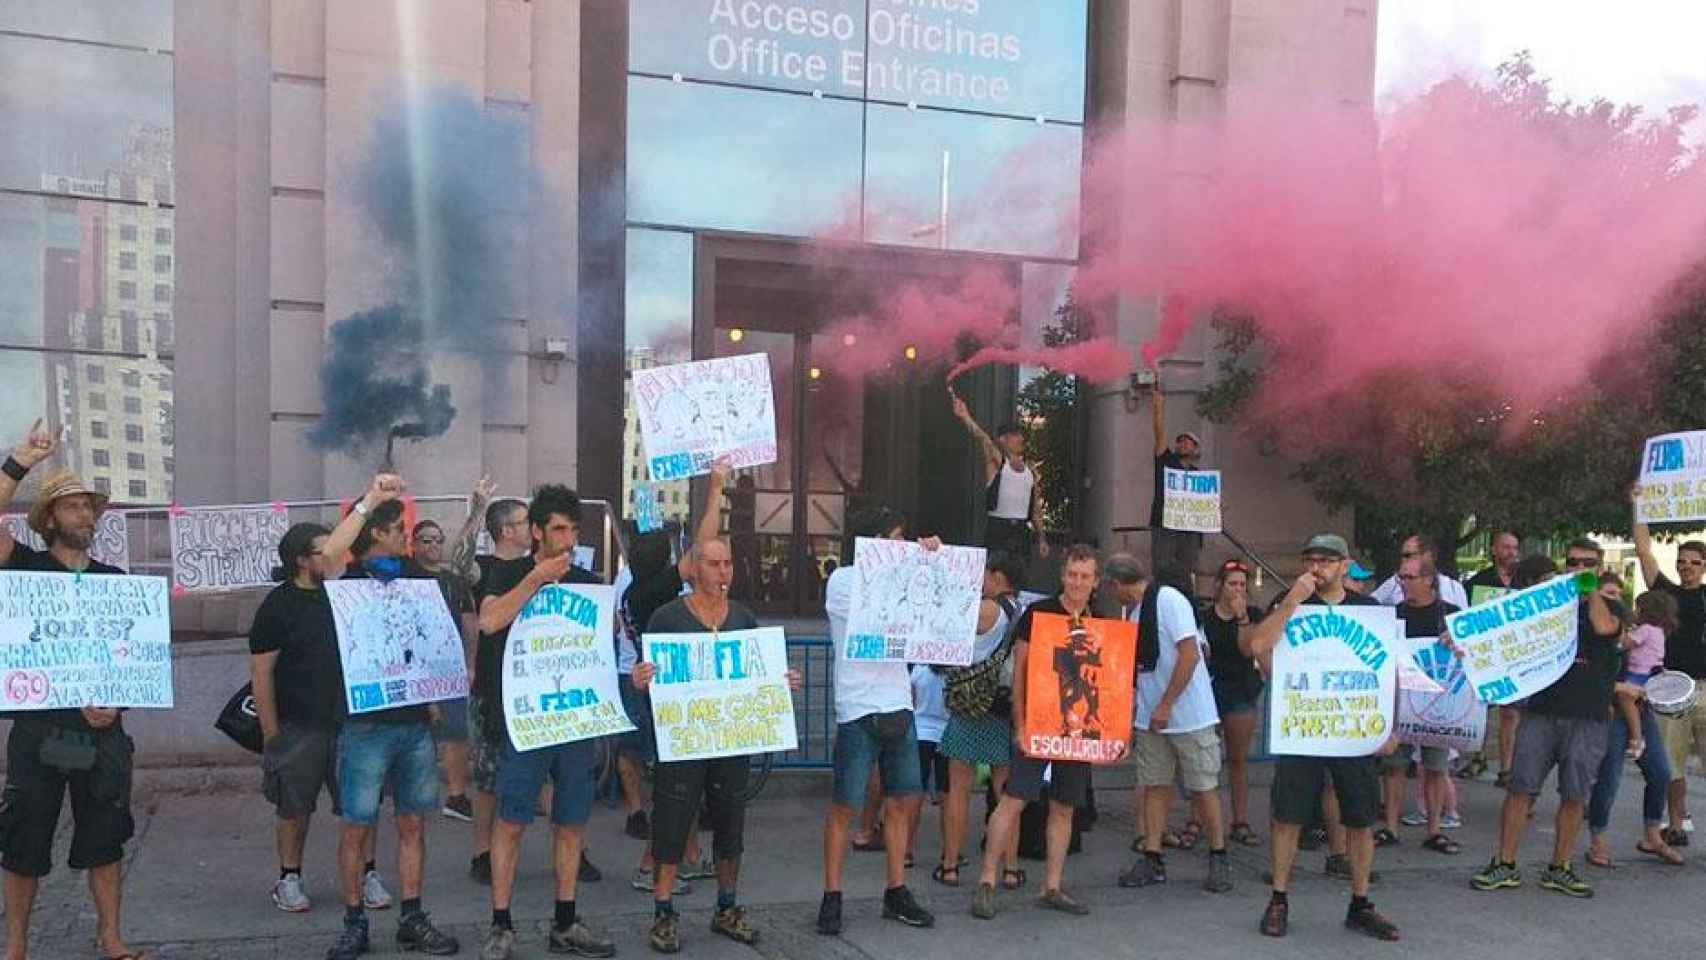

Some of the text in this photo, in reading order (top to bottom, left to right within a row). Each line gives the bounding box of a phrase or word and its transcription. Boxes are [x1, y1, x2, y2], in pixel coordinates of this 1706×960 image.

[709, 0, 1022, 61] Acceso Oficinas
[707, 34, 1010, 103] Office Entrance
[540, 688, 599, 713] FIRA
[1284, 670, 1380, 691] LA FIRA
